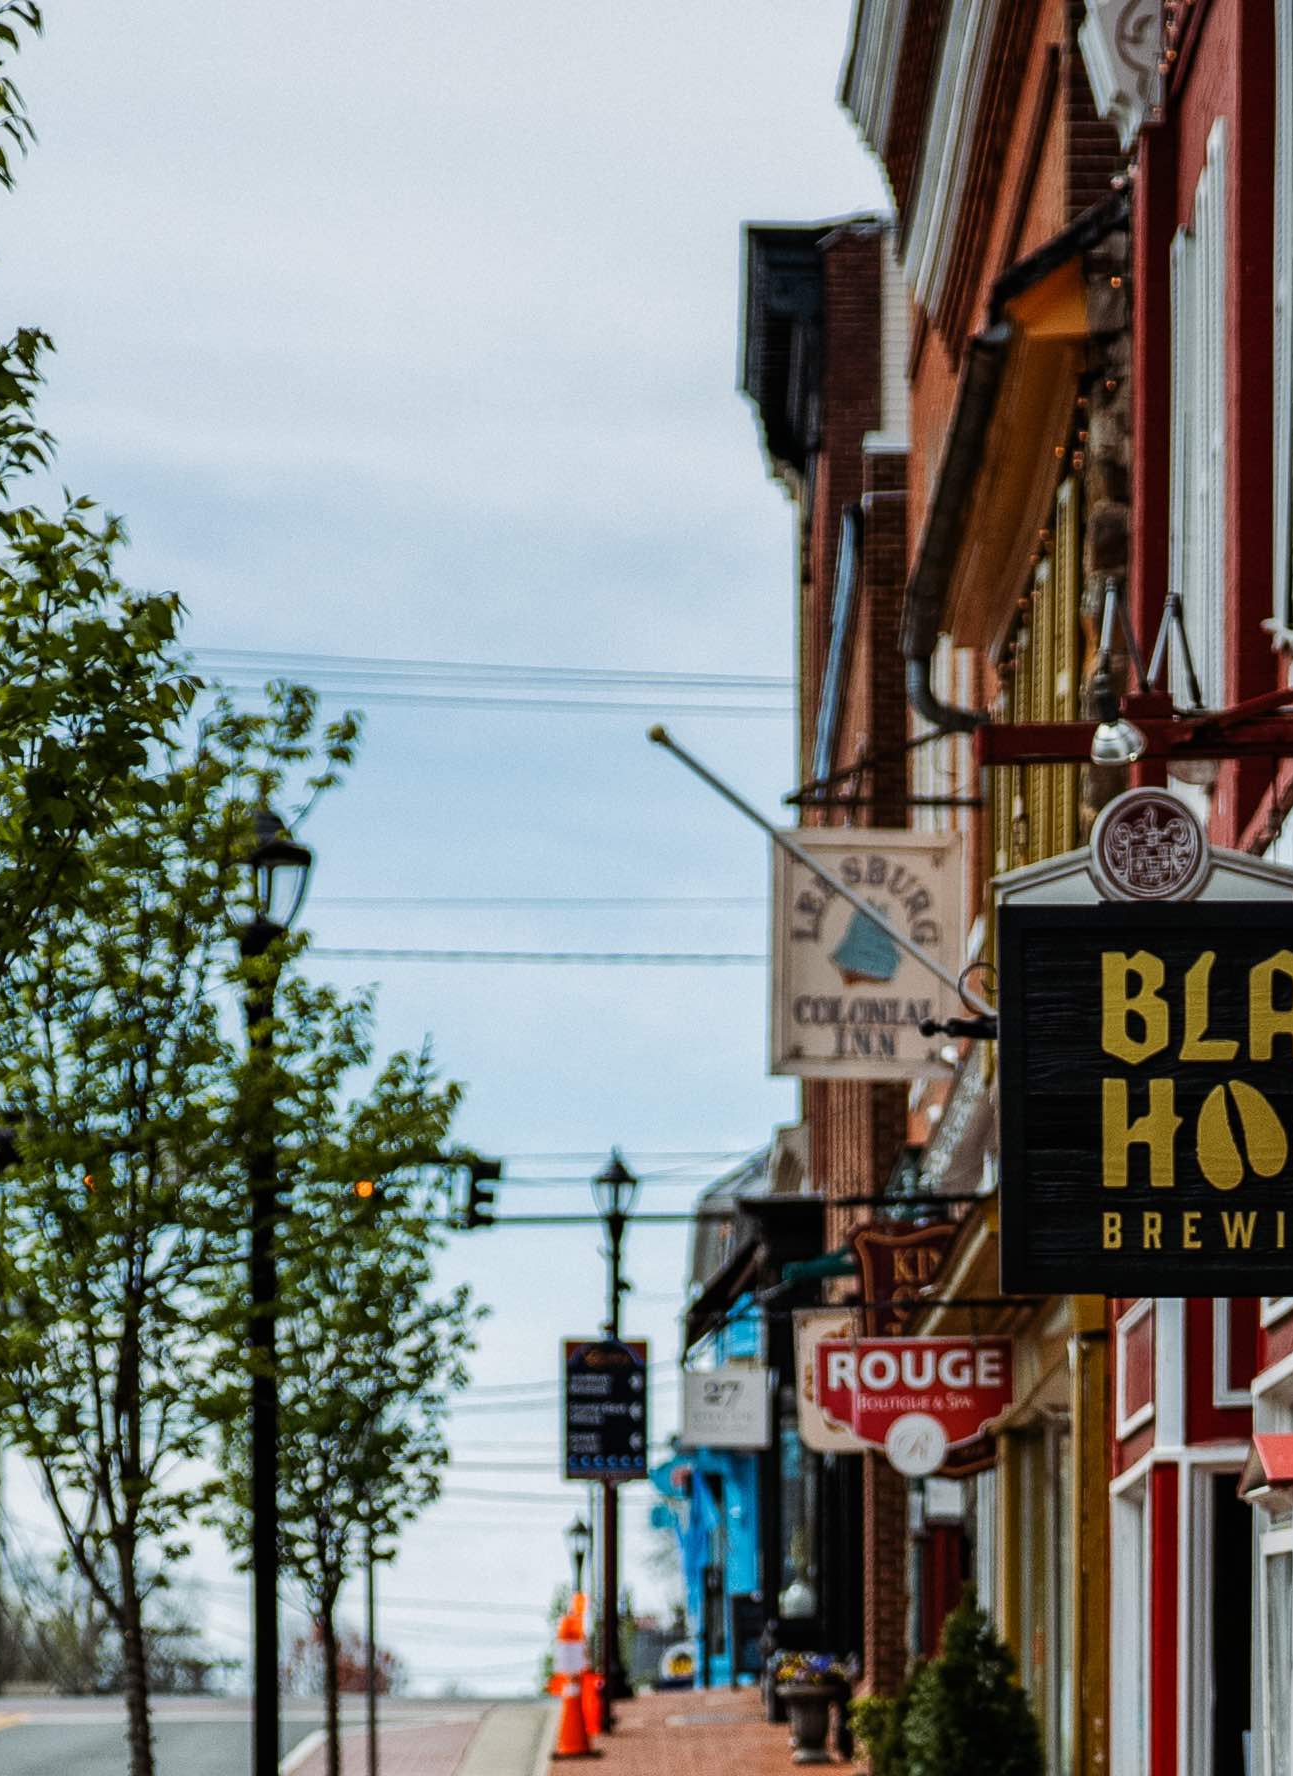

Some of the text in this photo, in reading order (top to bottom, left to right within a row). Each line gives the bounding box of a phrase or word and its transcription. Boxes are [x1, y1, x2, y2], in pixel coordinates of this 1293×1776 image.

[834, 1026, 898, 1058] INN
[826, 1349, 1004, 1391] ROUGE
[703, 1380, 742, 1408] 27
